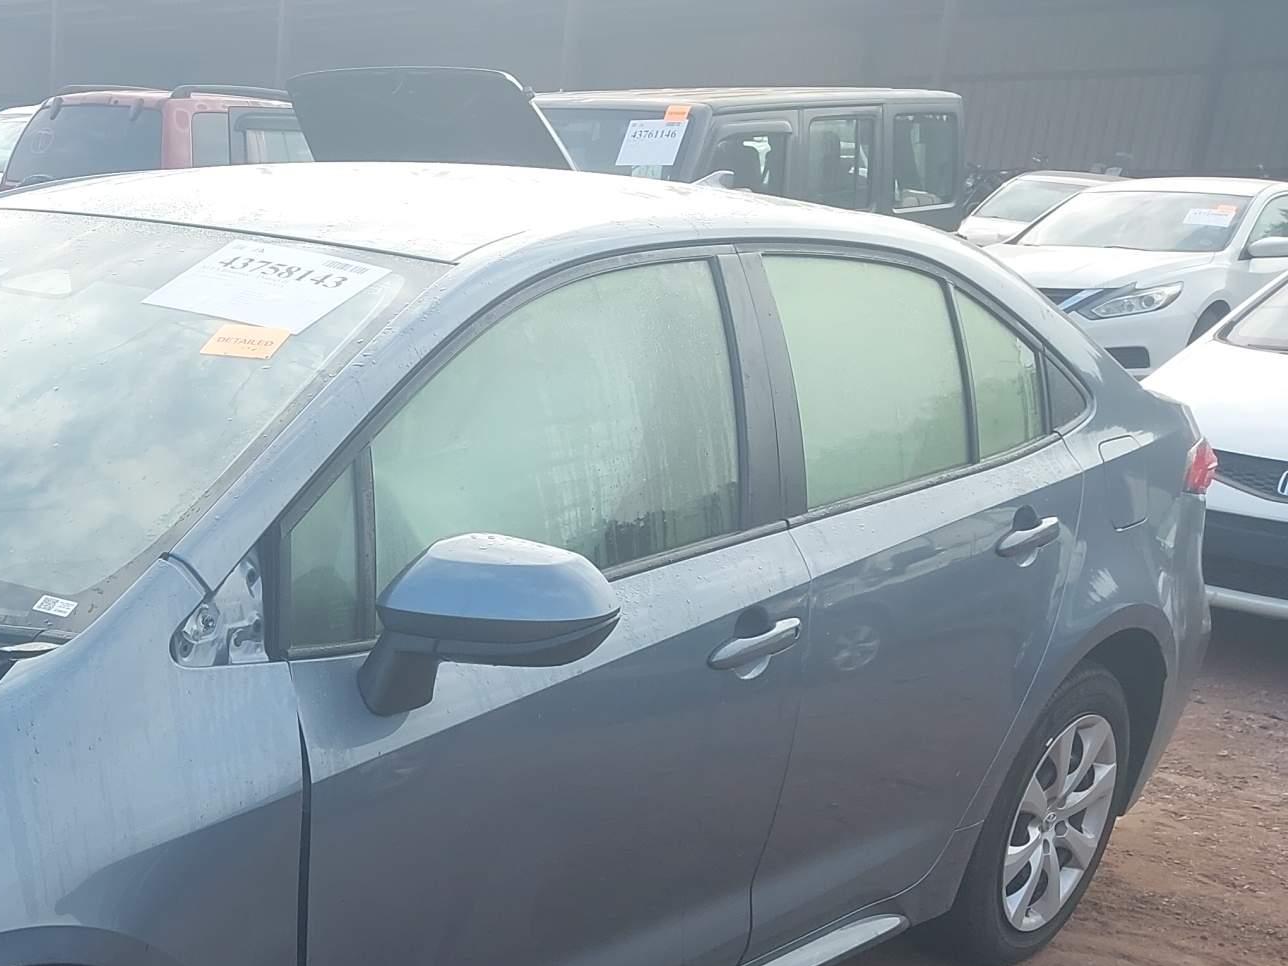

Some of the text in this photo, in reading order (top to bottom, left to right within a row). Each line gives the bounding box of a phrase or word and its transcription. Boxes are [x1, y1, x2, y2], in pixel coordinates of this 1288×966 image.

[632, 130, 677, 139] 43761146
[218, 255, 349, 289] 43758143
[216, 336, 275, 347] DETAILED
